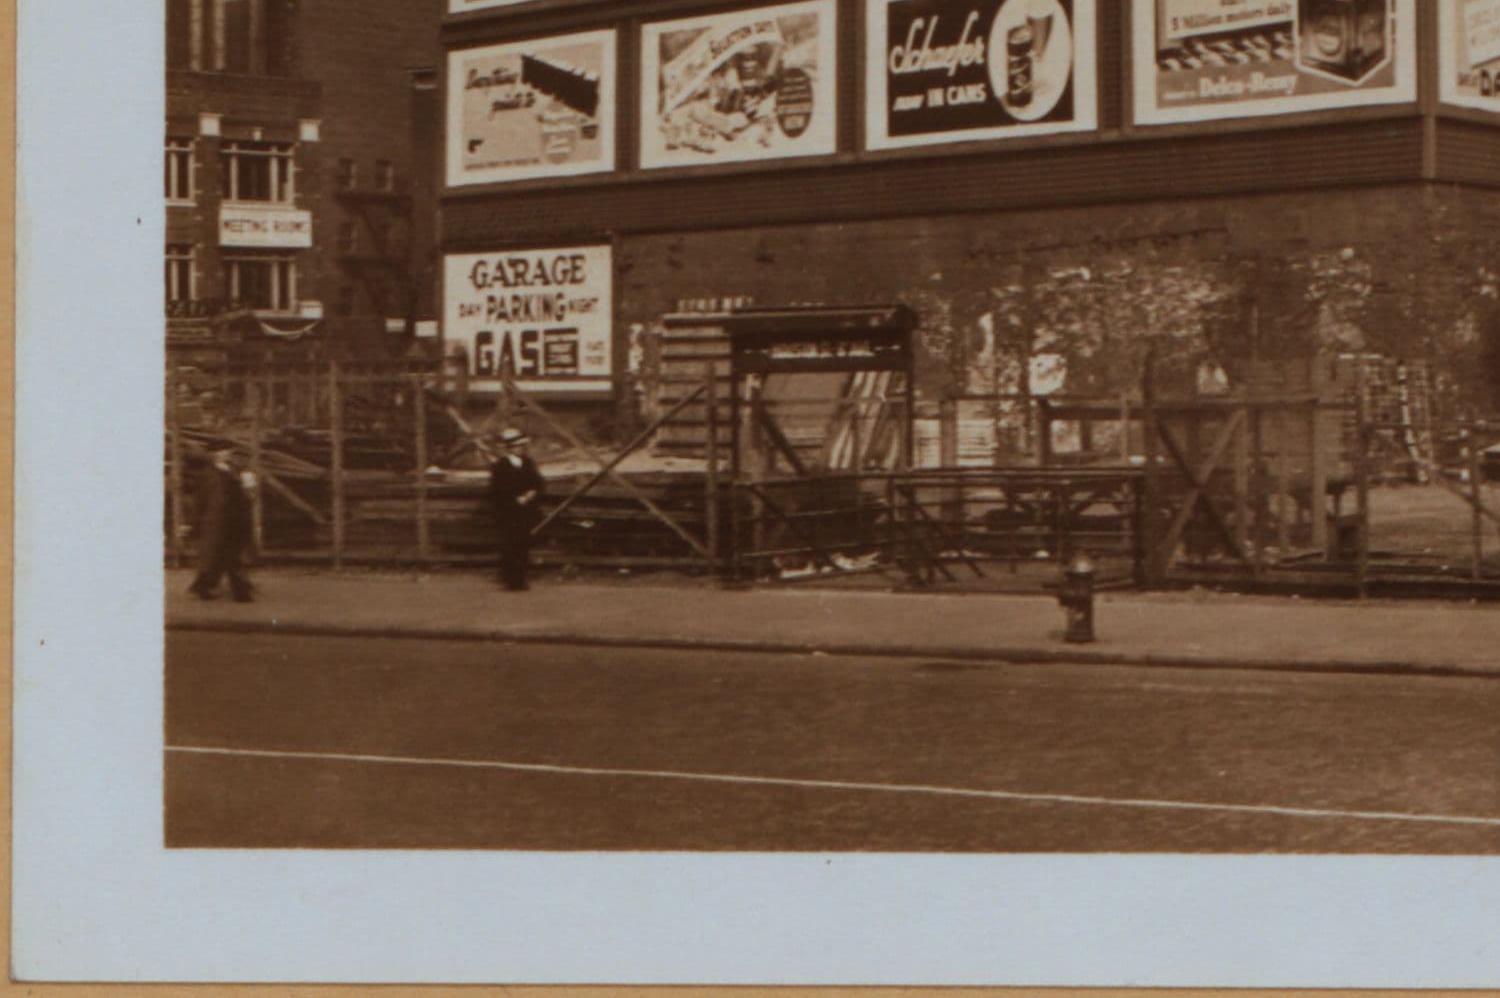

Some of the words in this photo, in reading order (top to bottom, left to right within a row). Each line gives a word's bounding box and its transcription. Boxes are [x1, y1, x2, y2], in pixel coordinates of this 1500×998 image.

[469, 254, 586, 289] GARAGE
[459, 303, 481, 318] DAY
[486, 292, 566, 323] PARKING
[475, 329, 539, 376] GAS
